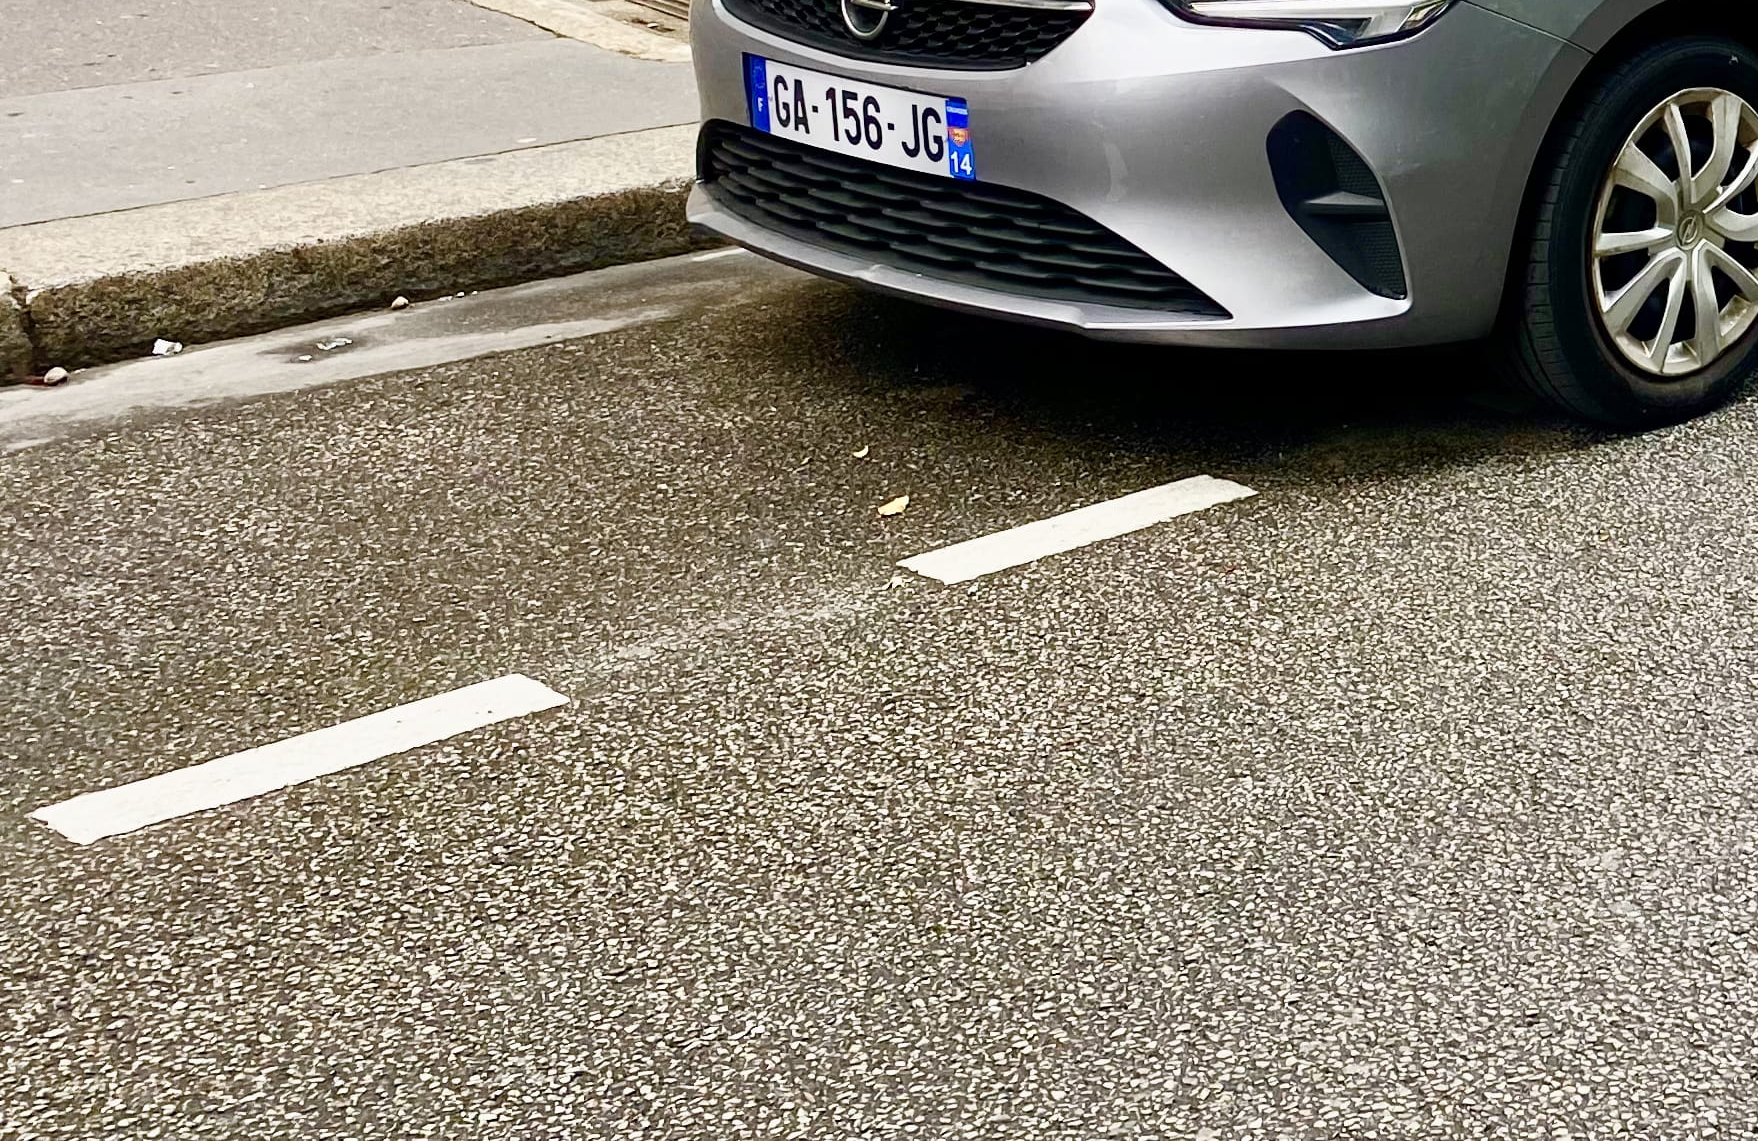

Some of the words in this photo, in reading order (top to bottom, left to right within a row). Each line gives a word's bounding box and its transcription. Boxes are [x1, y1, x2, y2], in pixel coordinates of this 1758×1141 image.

[757, 97, 764, 113] F
[774, 74, 944, 162] GA-156-JG
[950, 150, 972, 175] 14
